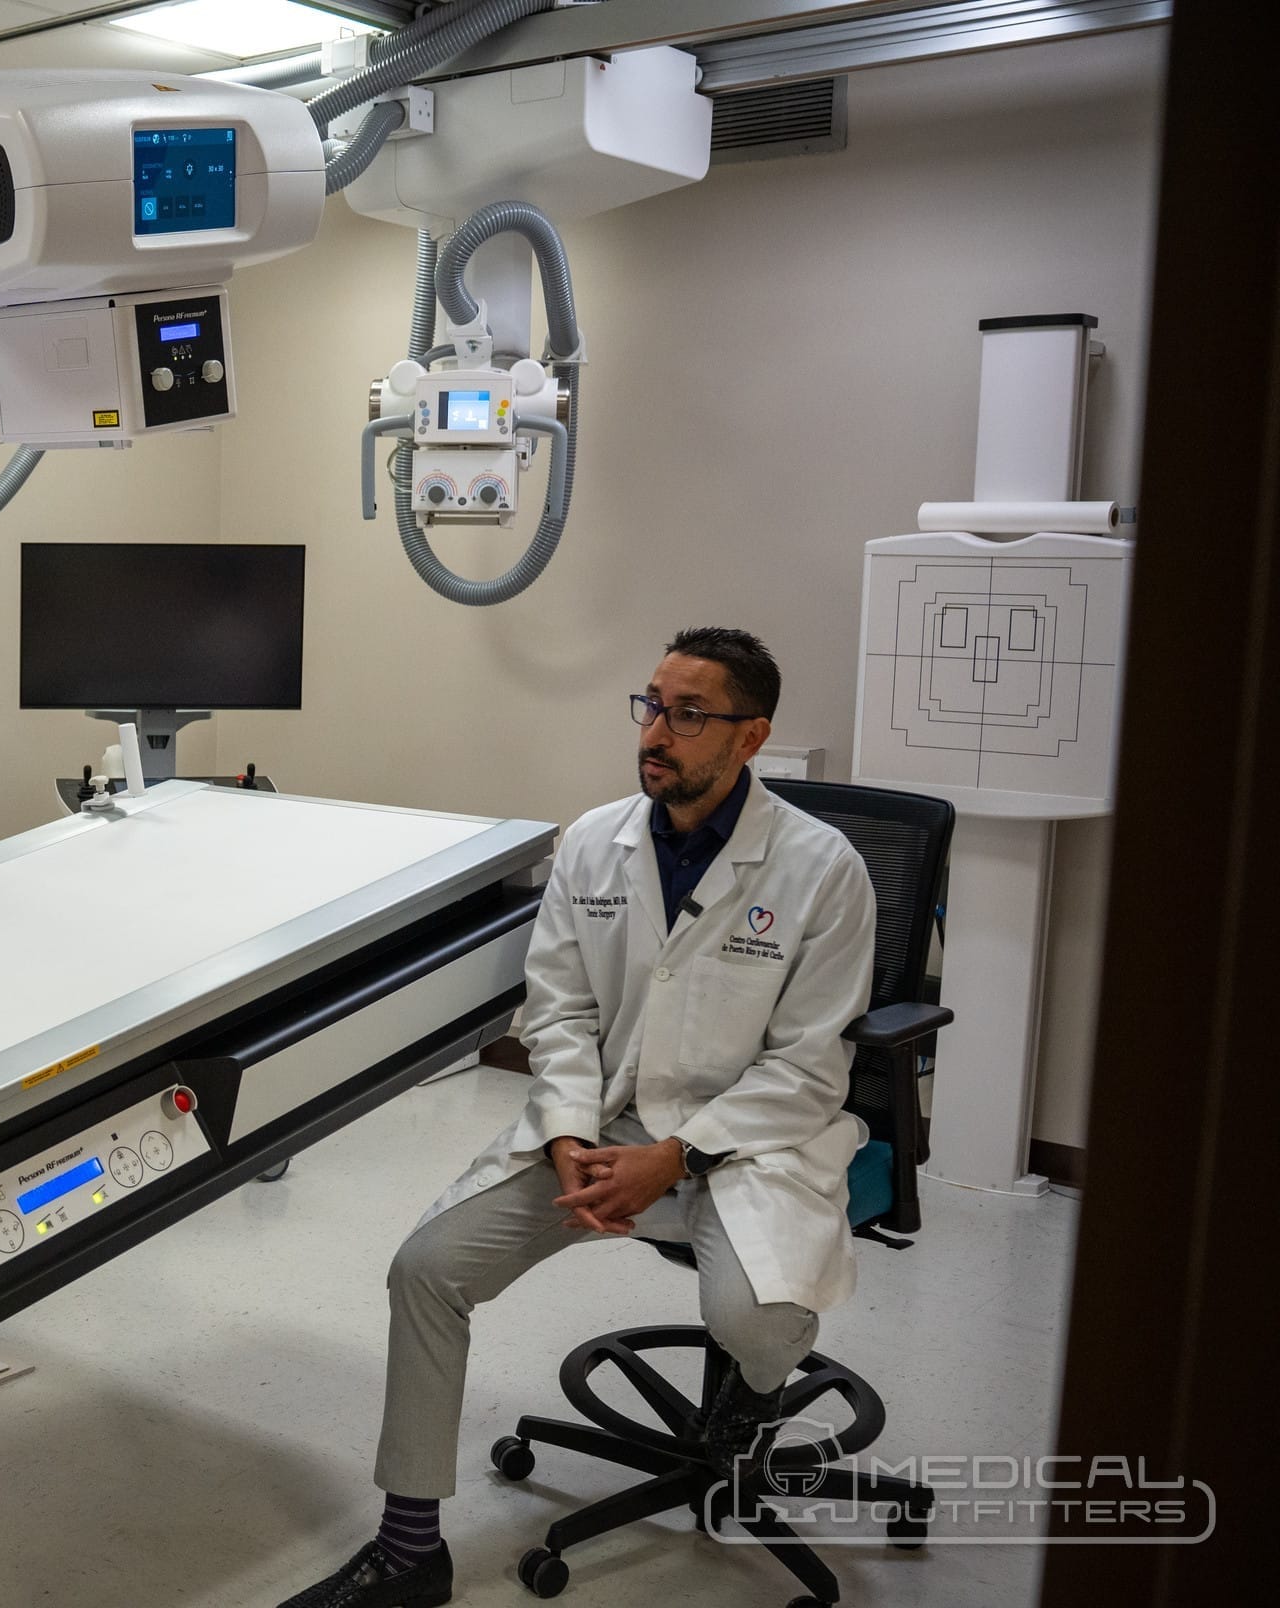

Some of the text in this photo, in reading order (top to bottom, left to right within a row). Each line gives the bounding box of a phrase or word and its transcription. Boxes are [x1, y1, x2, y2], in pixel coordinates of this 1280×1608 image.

[153, 314, 175, 323] Persona
[729, 934, 745, 944] Centro
[729, 944, 744, 953] Puerto
[746, 946, 756, 955] Rico
[770, 950, 784, 960] Caribe
[18, 1168, 45, 1185] Persona
